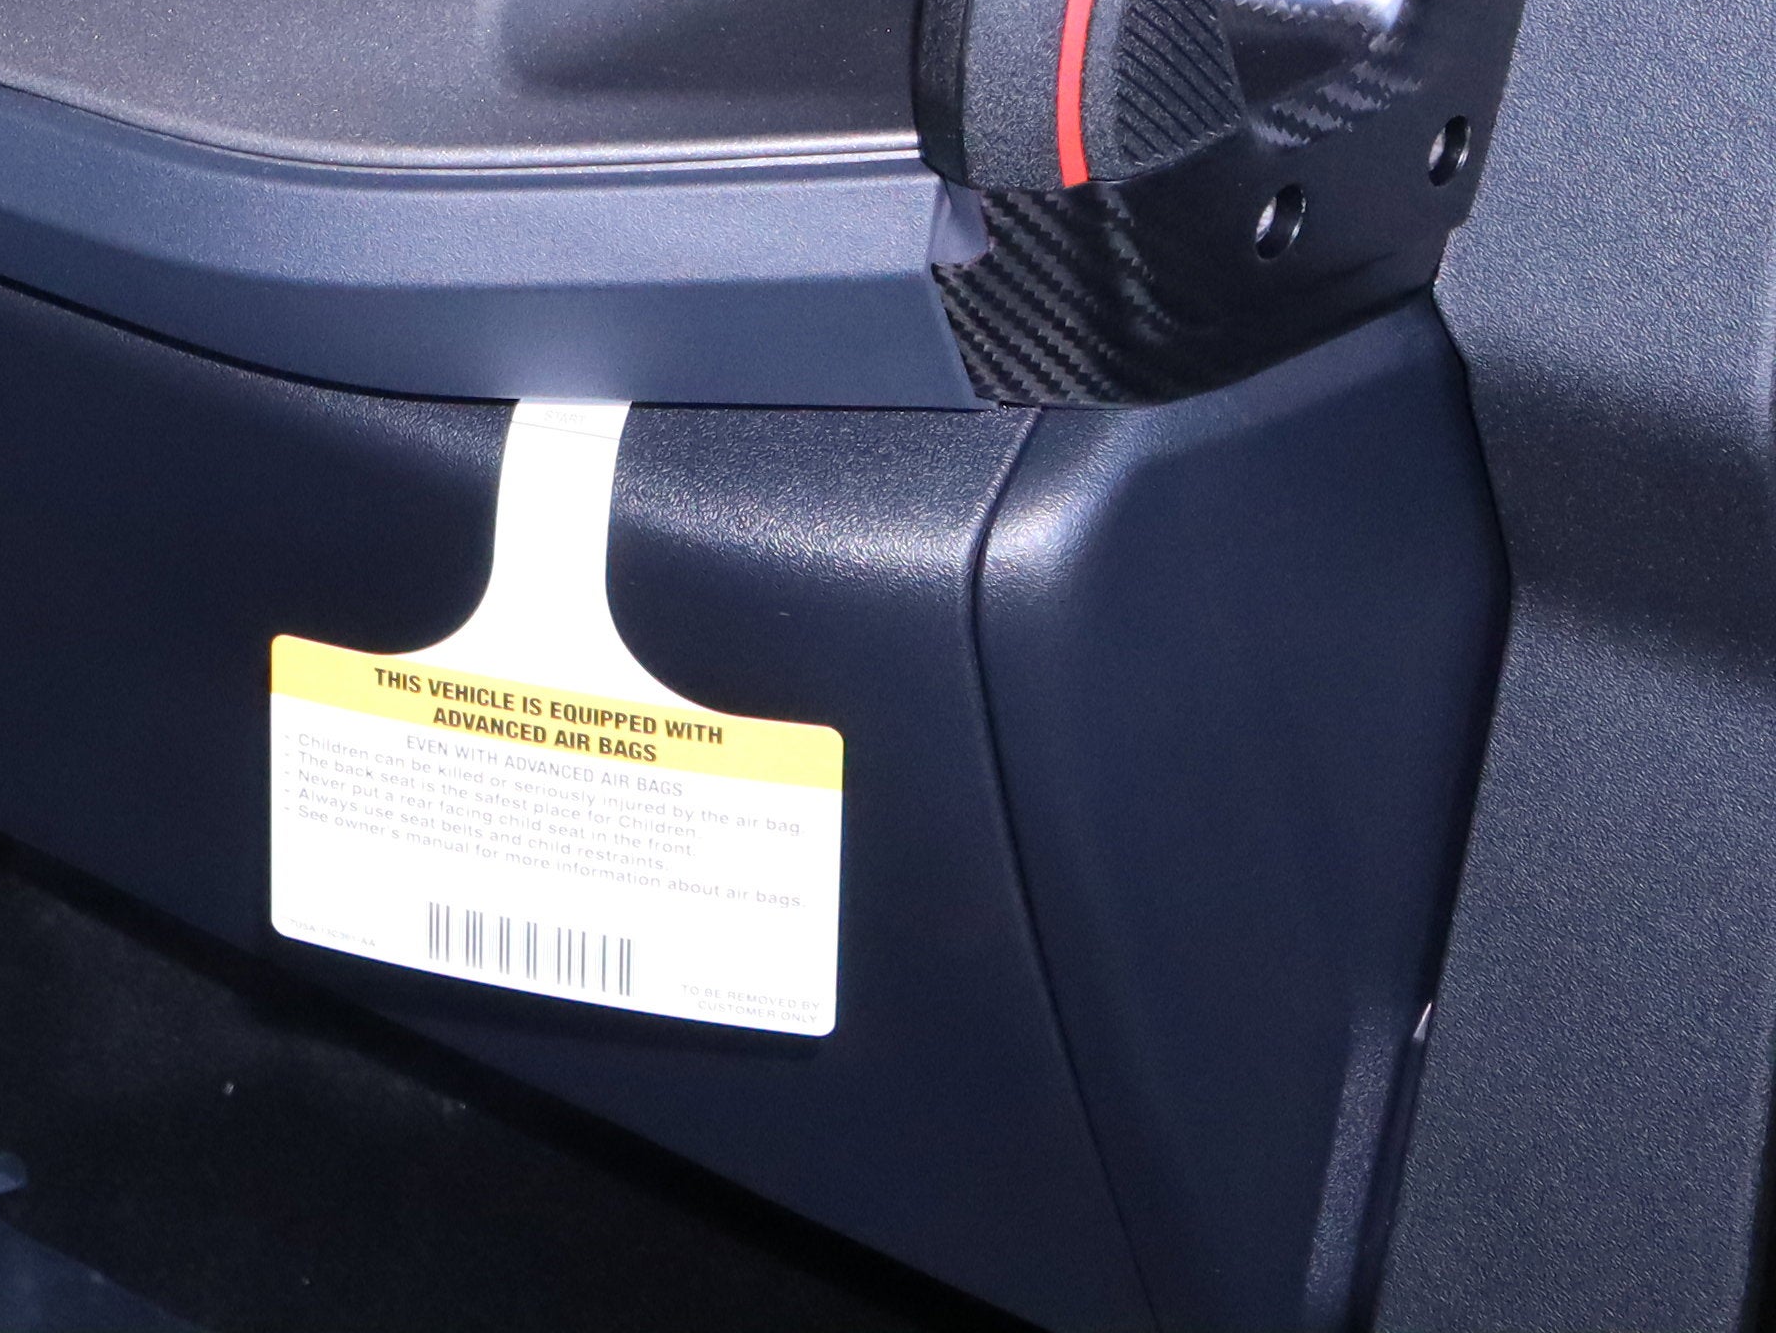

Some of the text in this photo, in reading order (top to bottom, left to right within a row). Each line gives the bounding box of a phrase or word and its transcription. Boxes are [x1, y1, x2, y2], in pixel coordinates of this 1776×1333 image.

[374, 666, 724, 745] THIS VEHICLE IS EQUIPPED WITH
[432, 706, 658, 764] ADVANCED AIR BAGS
[298, 733, 806, 837] Children can be killed or seriously injured by the air bag.
[298, 750, 702, 839] The back seat is the safest place for Children.
[407, 735, 683, 797] EVEN WITH ADVANCED AIR BAGS
[298, 769, 696, 857] Never put a rear facing child seat in the front.
[298, 788, 669, 871] Always use seat belts and child restraints.
[298, 805, 806, 909] See owner's manual for more information about air bags.
[681, 984, 820, 1010] TO BE REMOVED BY
[698, 1000, 818, 1023] CUSTOMER ONLY
